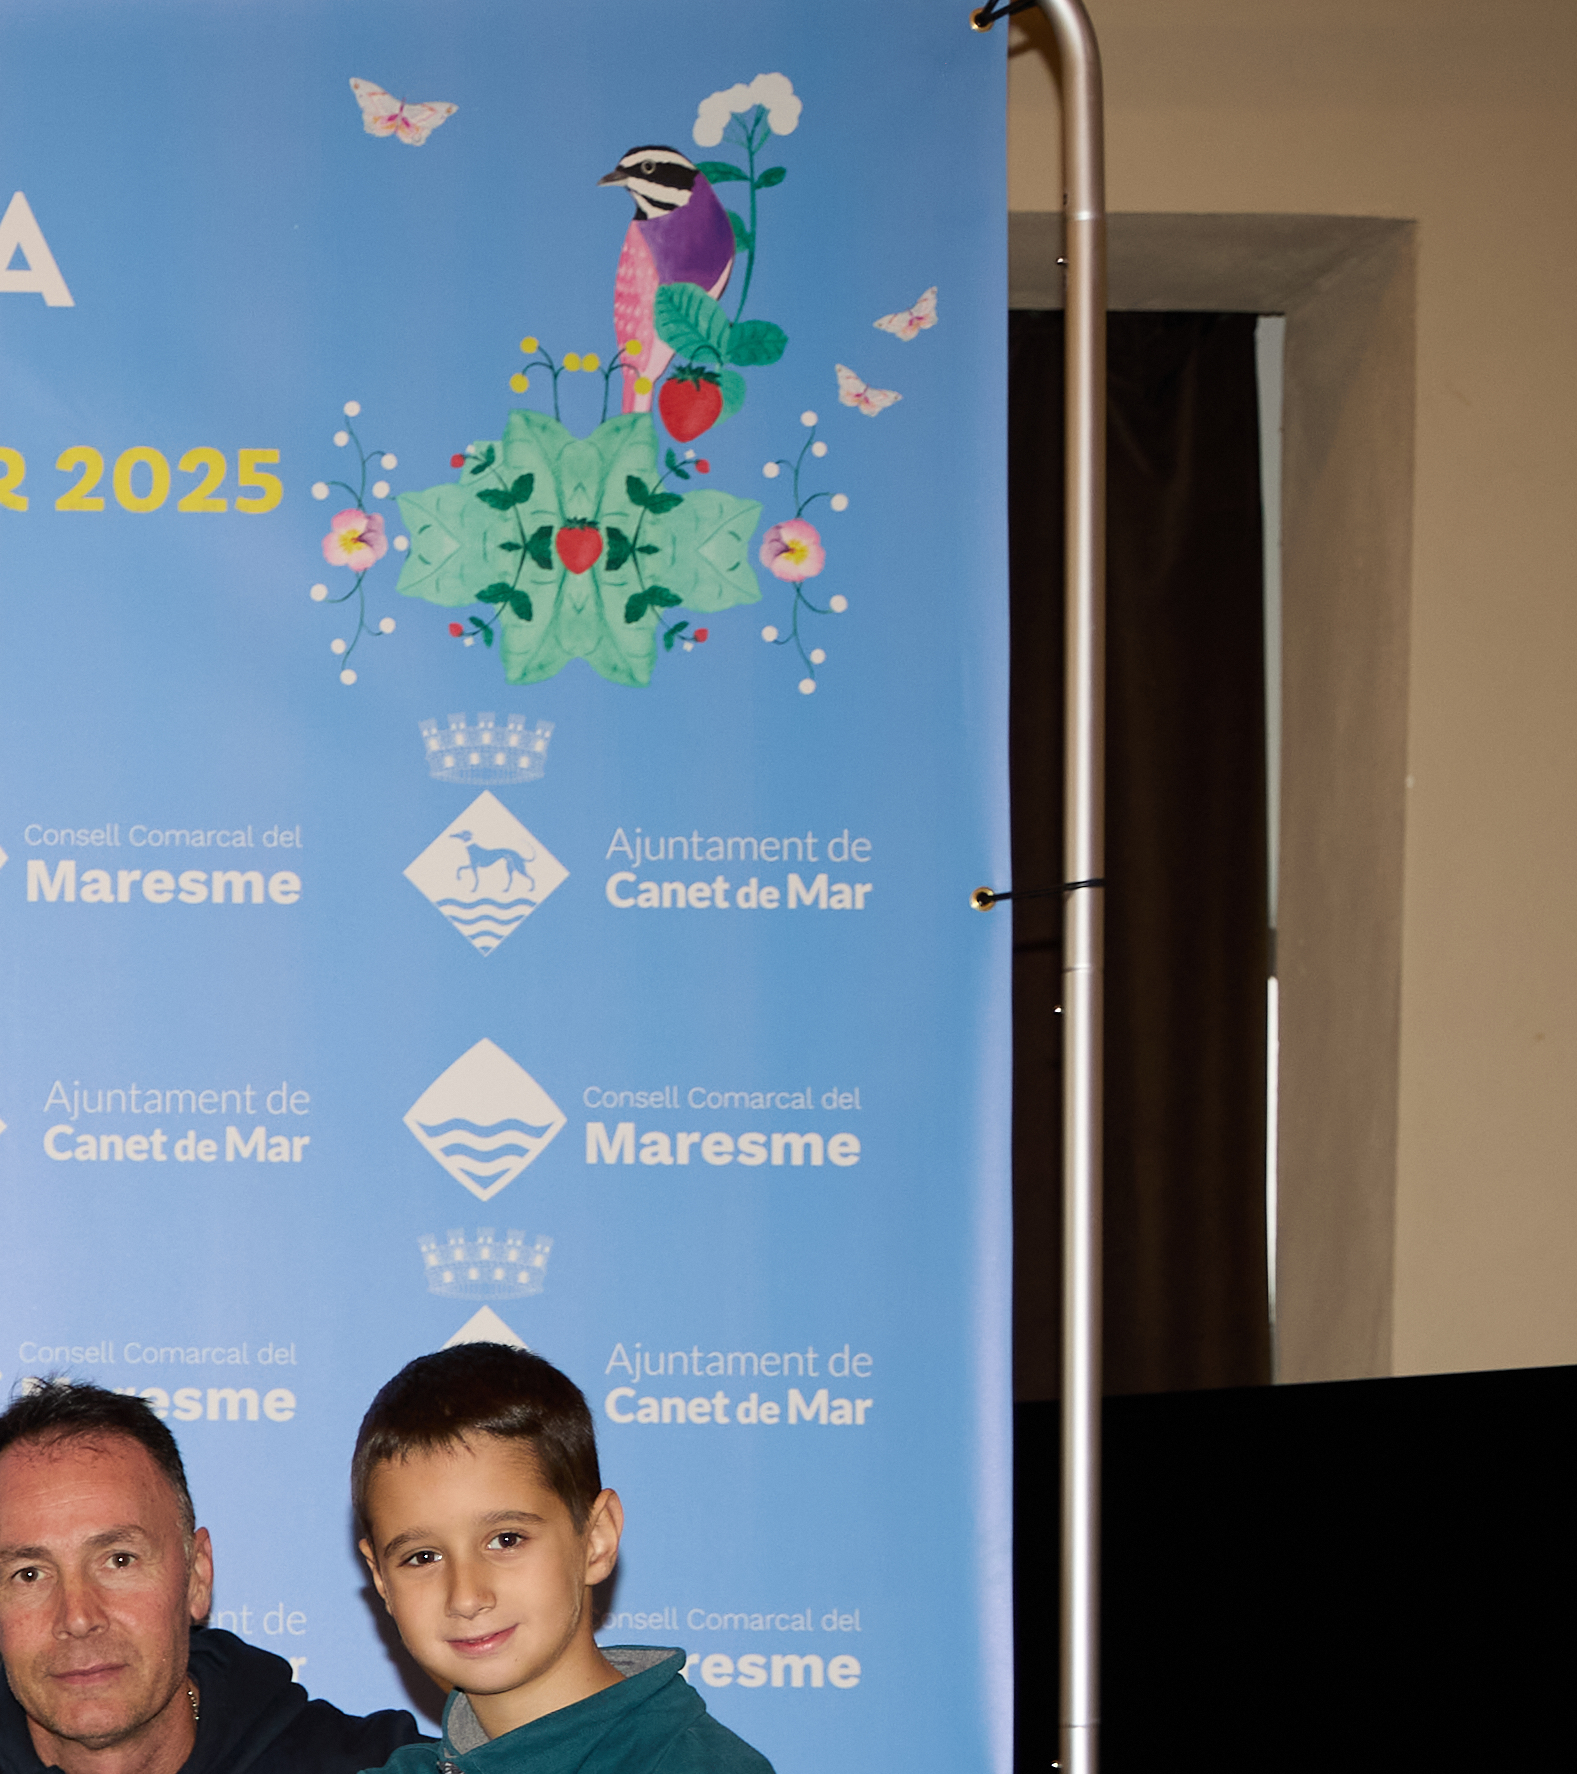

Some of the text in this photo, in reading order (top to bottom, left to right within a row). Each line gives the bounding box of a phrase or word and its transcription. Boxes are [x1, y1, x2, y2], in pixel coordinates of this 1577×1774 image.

[55, 445, 283, 514] 2025
[23, 822, 303, 849] Consell Comarcal del
[605, 826, 873, 869] Ajuntament de
[26, 859, 302, 905] Maresme
[605, 870, 873, 910] Canet de Mar
[43, 1079, 312, 1122] Ajuntament de
[582, 1085, 862, 1111] Consell Comarcal del
[43, 1123, 311, 1163] Canet de Mar
[585, 1121, 862, 1167] Maresme
[18, 1340, 298, 1366] Consell Comarcal del
[604, 1341, 874, 1384] Ajuntament de
[604, 1386, 874, 1426] Canet de Mar
[263, 1602, 307, 1635] de
[603, 1607, 862, 1633] onsell Comarcal del
[682, 1653, 862, 1690] resme
